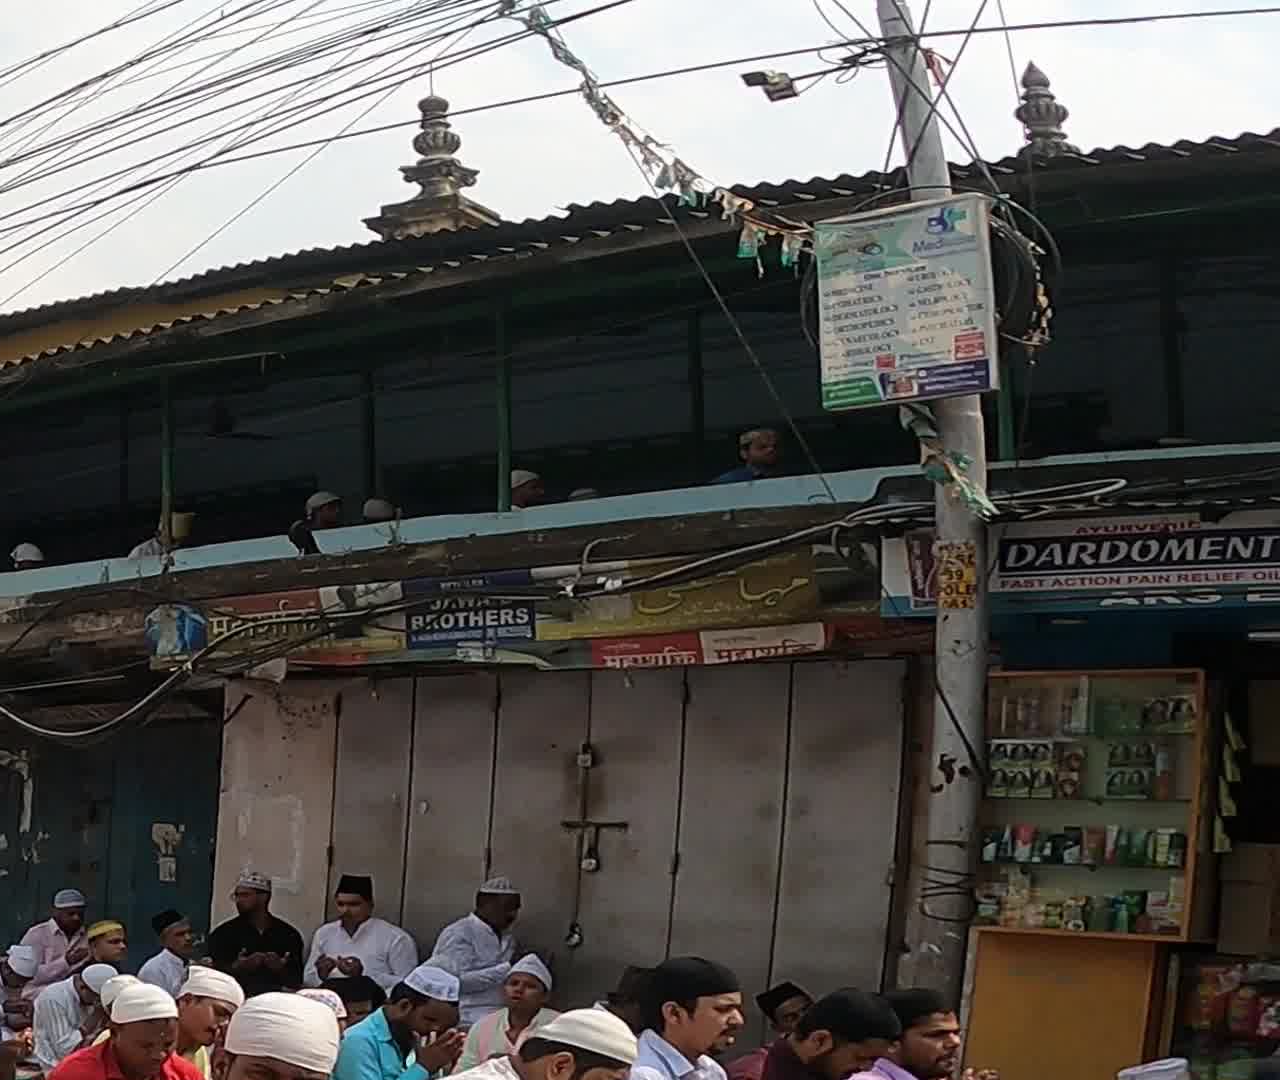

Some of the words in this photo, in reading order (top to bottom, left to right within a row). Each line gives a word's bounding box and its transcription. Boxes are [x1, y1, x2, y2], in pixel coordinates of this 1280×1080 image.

[1000, 578, 1045, 589] FAST
[1051, 575, 1122, 588] ACTION
[1127, 574, 1171, 585] PAIN
[1174, 570, 1243, 584] RELIEF
[411, 607, 530, 631] BROTHERS
